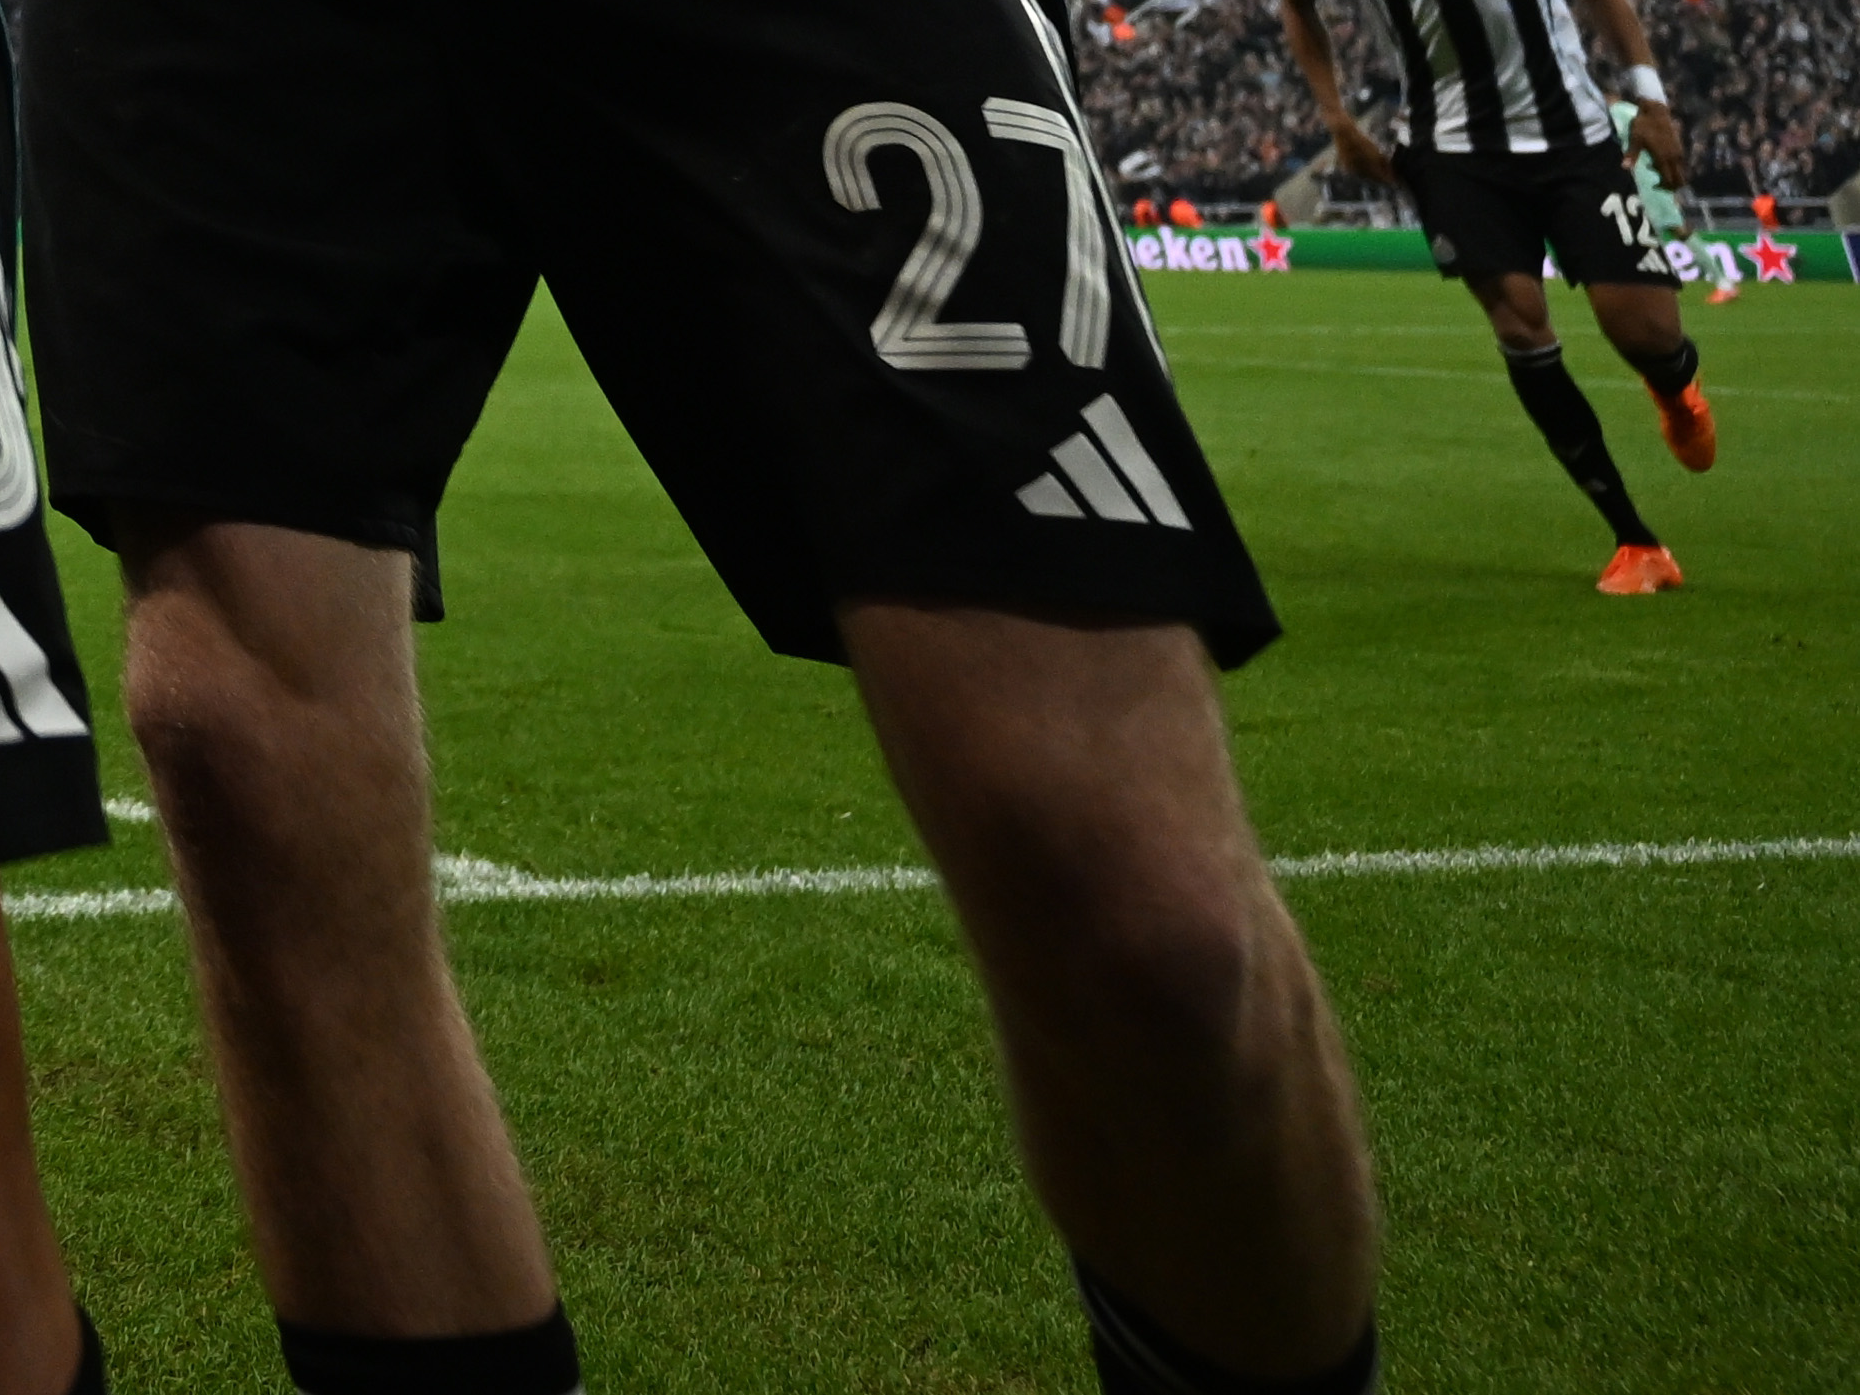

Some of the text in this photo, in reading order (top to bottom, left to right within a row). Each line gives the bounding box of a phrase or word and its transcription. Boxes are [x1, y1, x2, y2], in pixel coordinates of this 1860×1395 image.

[821, 96, 1112, 370] 27
[1599, 192, 1659, 247] 12
[1127, 224, 1250, 272] eken
